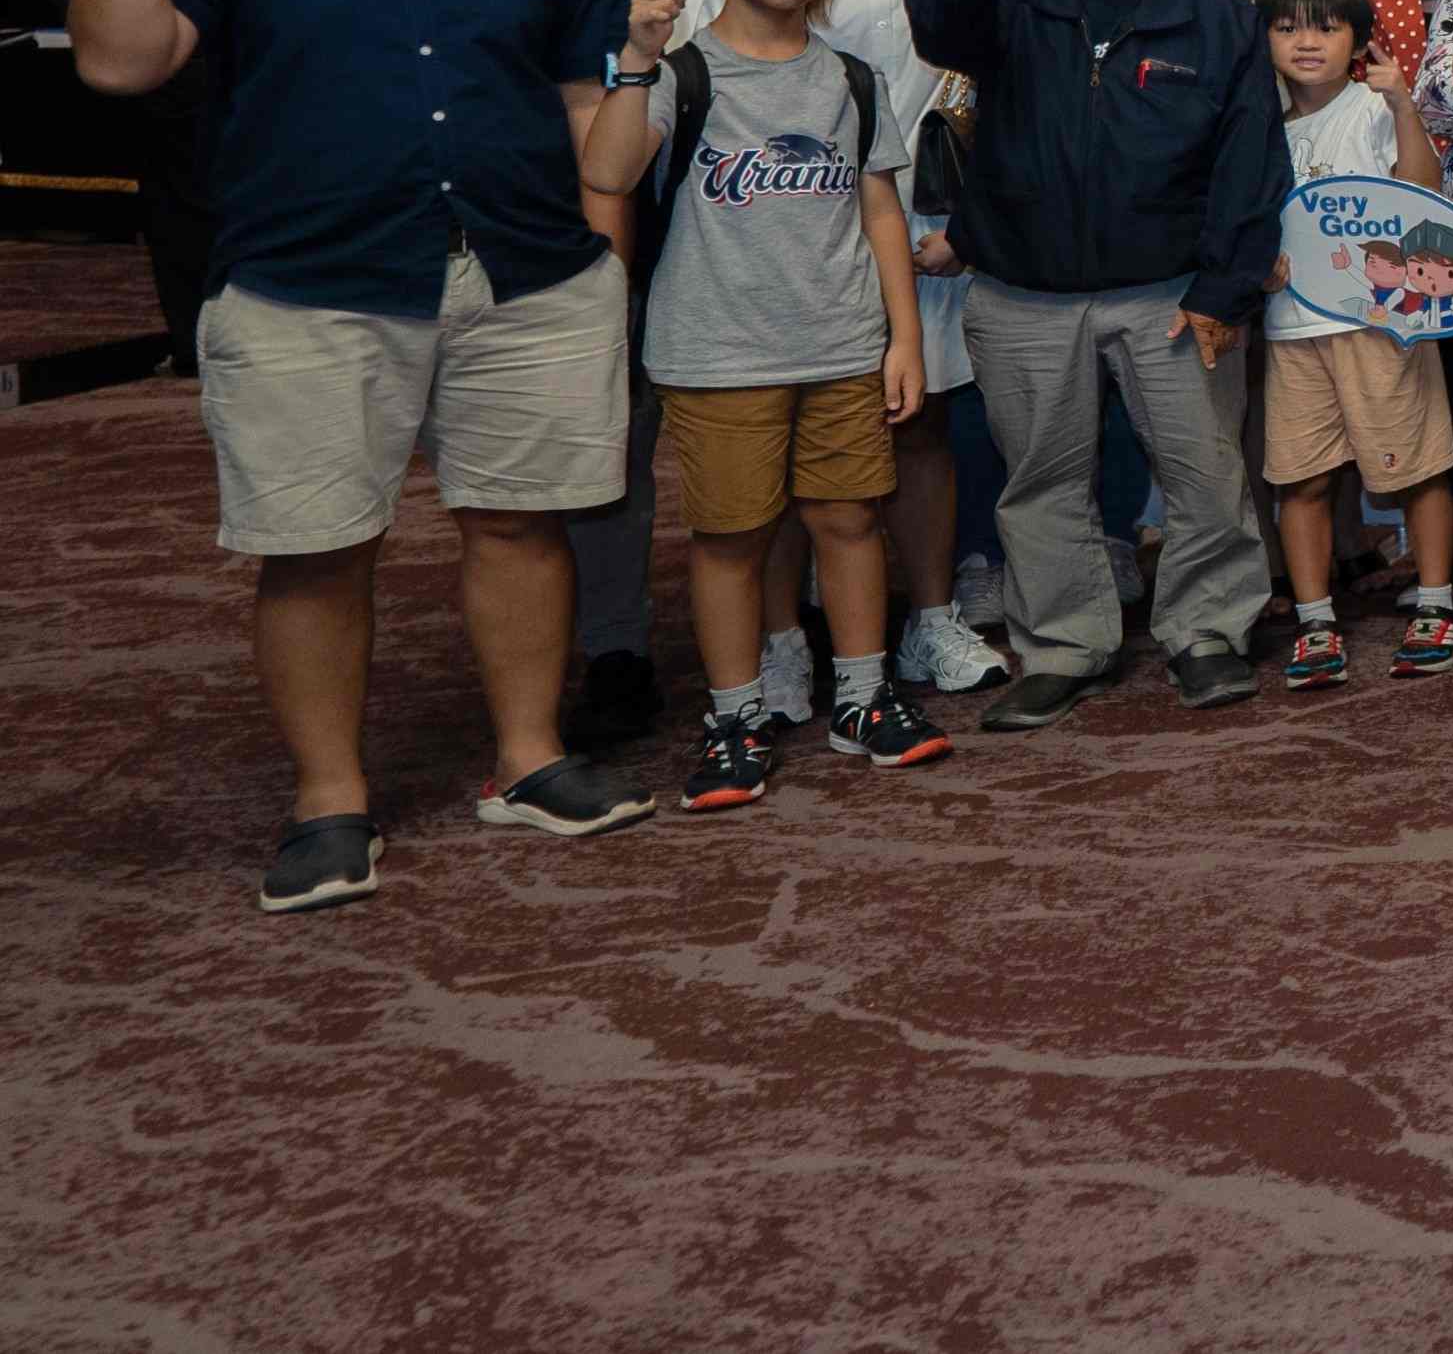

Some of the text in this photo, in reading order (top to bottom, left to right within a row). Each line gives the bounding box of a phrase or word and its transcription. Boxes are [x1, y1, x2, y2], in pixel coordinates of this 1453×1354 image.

[693, 144, 859, 207] Urania
[1299, 192, 1368, 216] Very
[1318, 215, 1402, 238] Good
